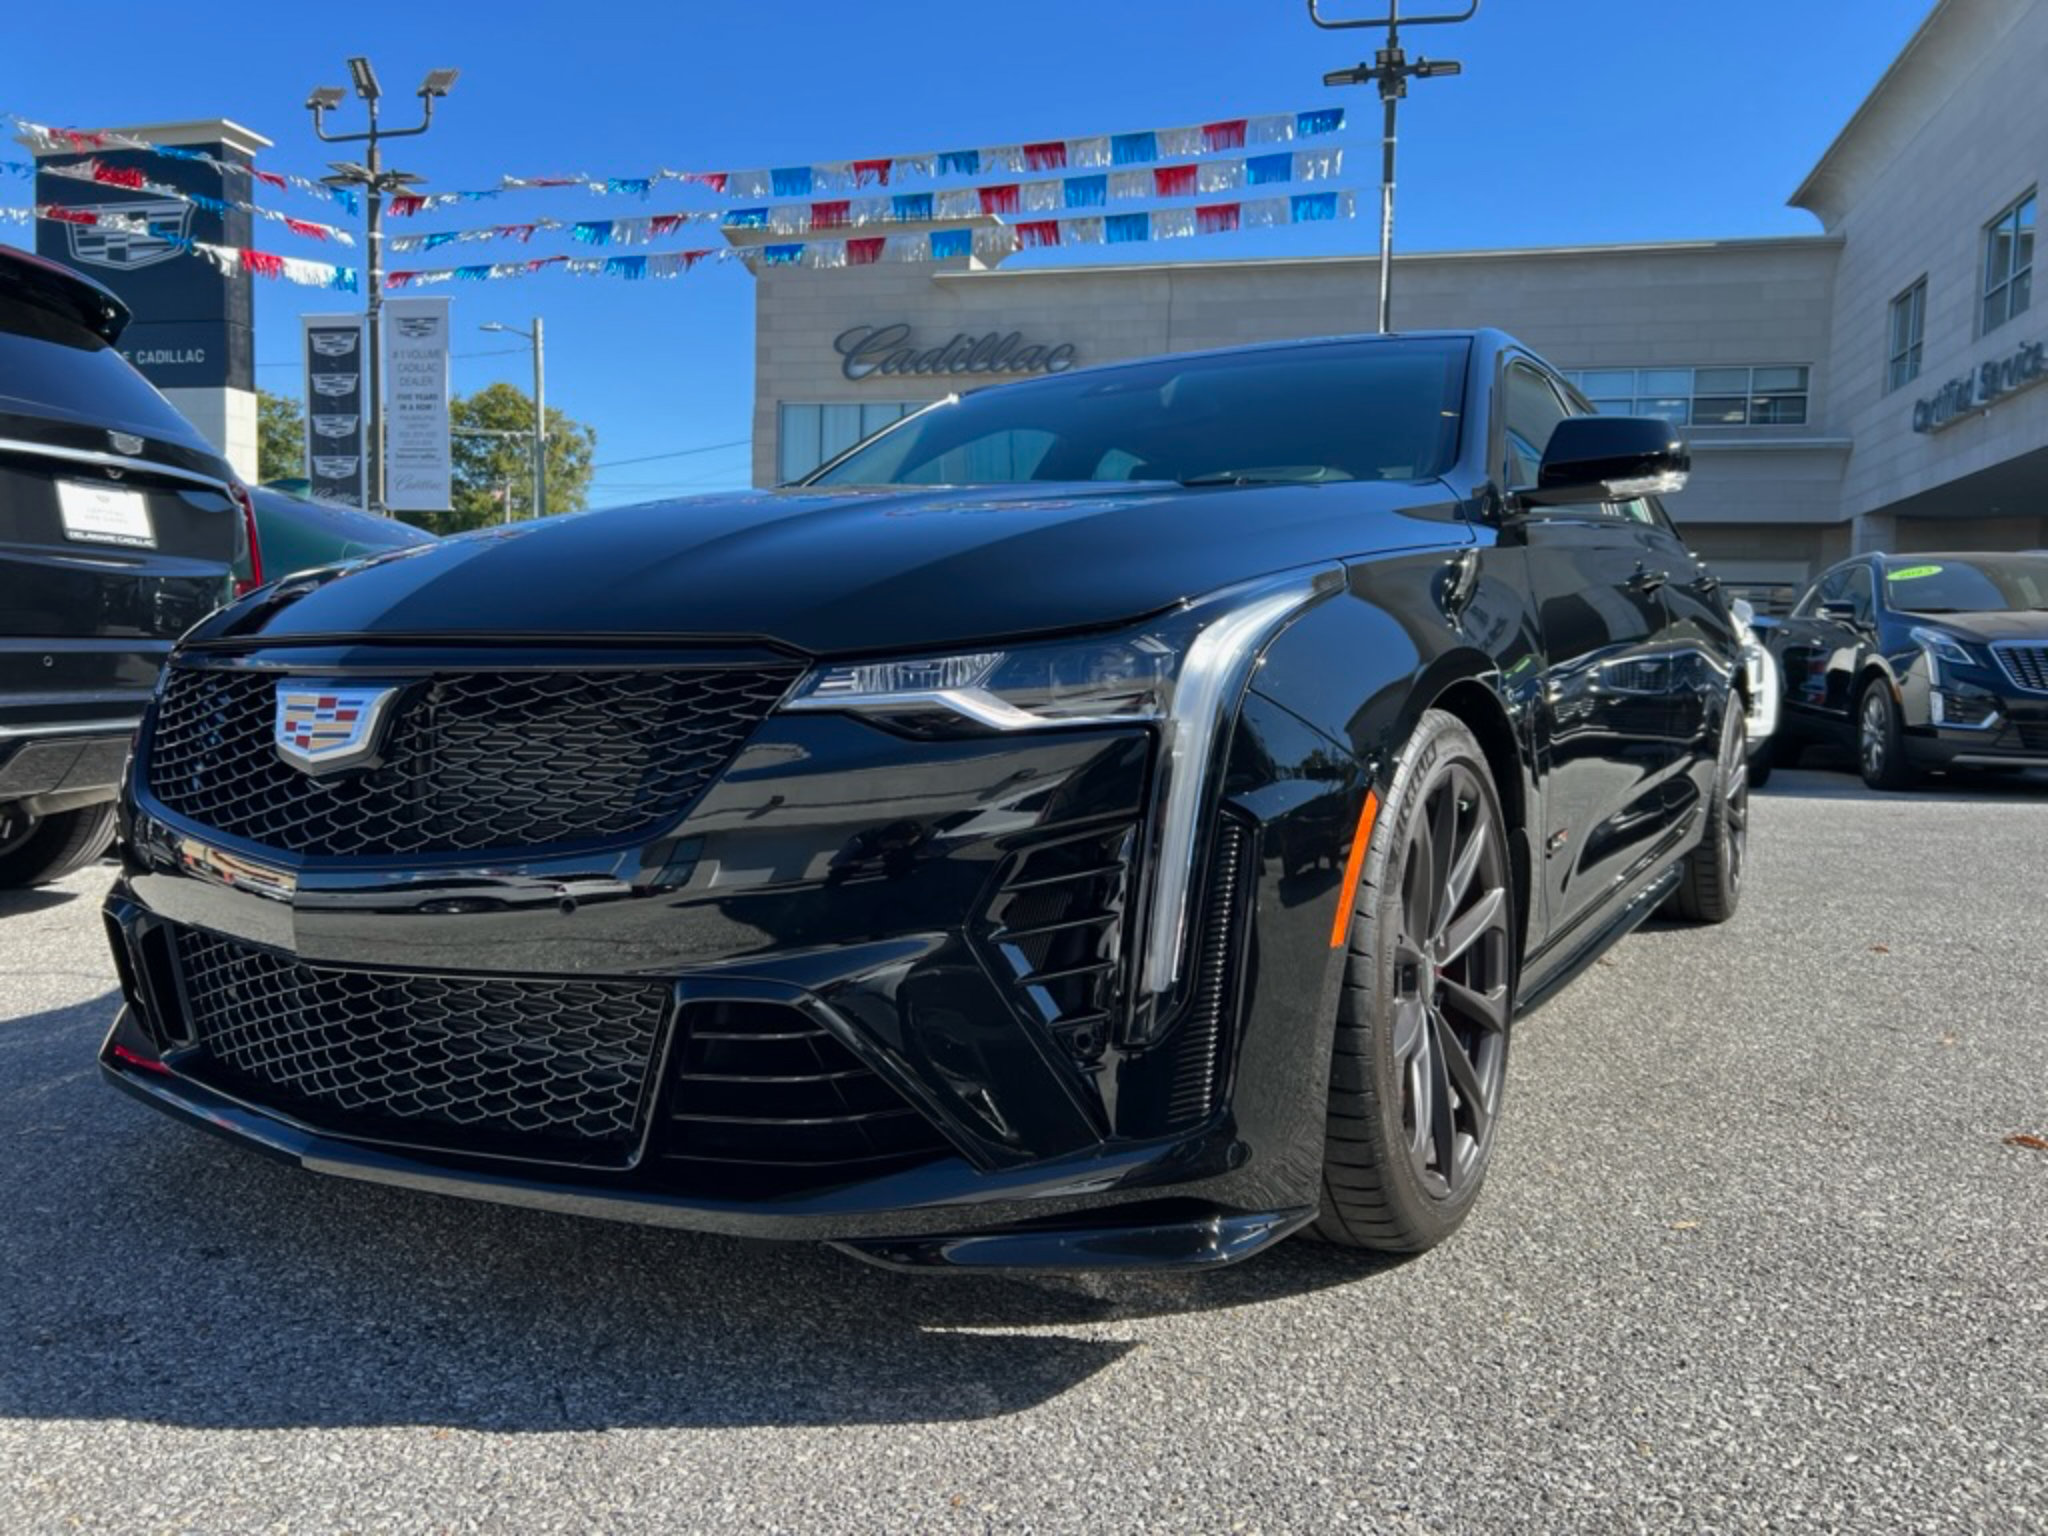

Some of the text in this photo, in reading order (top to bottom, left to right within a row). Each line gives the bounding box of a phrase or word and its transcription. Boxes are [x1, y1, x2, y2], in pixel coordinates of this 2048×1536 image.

[136, 349, 206, 365] CADILLAC
[833, 323, 1076, 381] Cadillac
[397, 363, 439, 373] CADILLAC
[399, 376, 434, 387] DEALER
[1913, 341, 2043, 433] Certified Service
